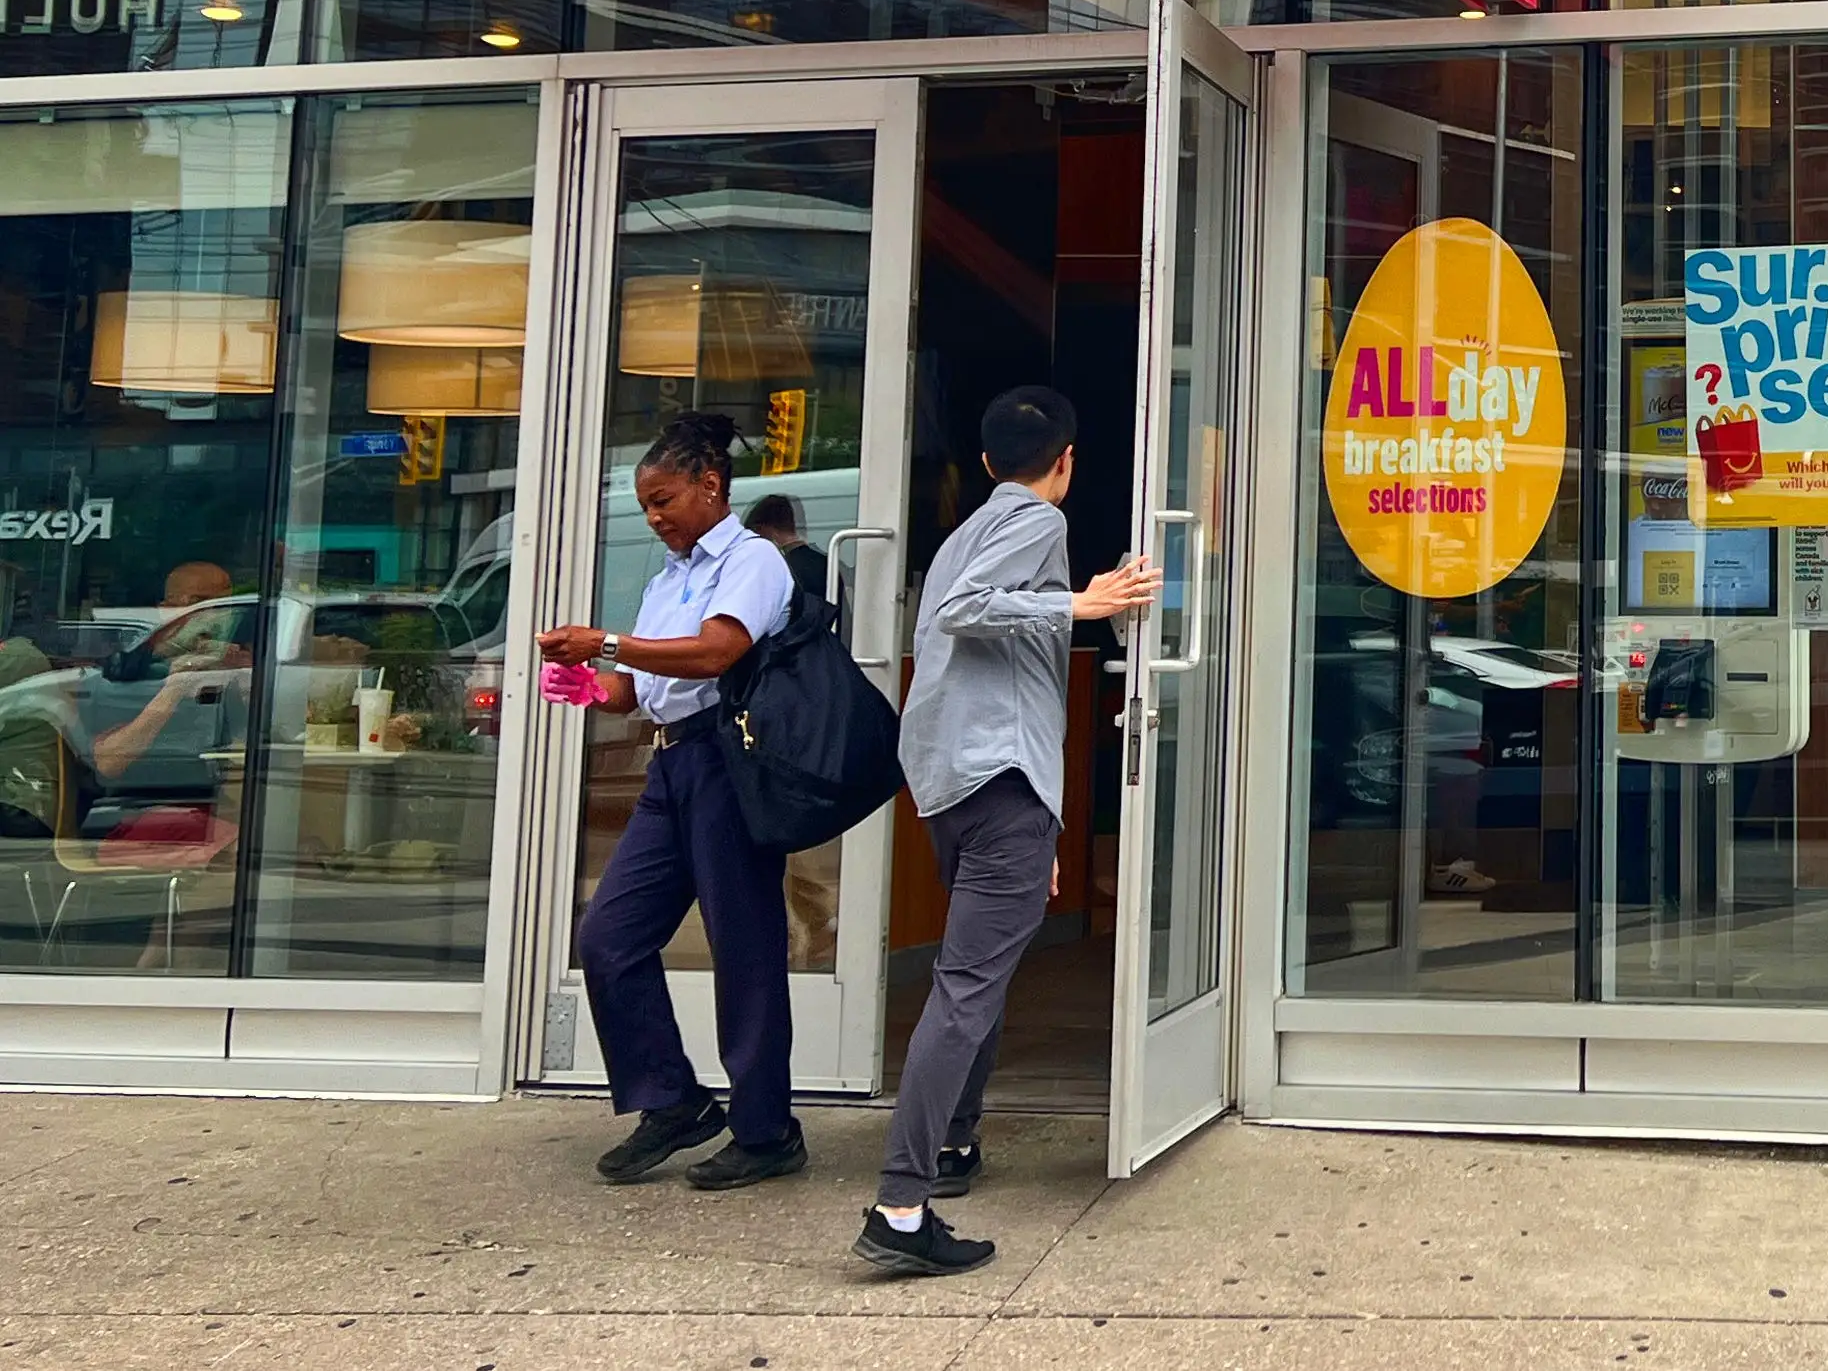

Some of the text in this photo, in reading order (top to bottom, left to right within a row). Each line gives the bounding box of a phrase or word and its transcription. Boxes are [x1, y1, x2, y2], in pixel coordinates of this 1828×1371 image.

[1344, 427, 1506, 475] breakfast
[1368, 482, 1487, 514] selections
[1779, 476, 1804, 489] will
